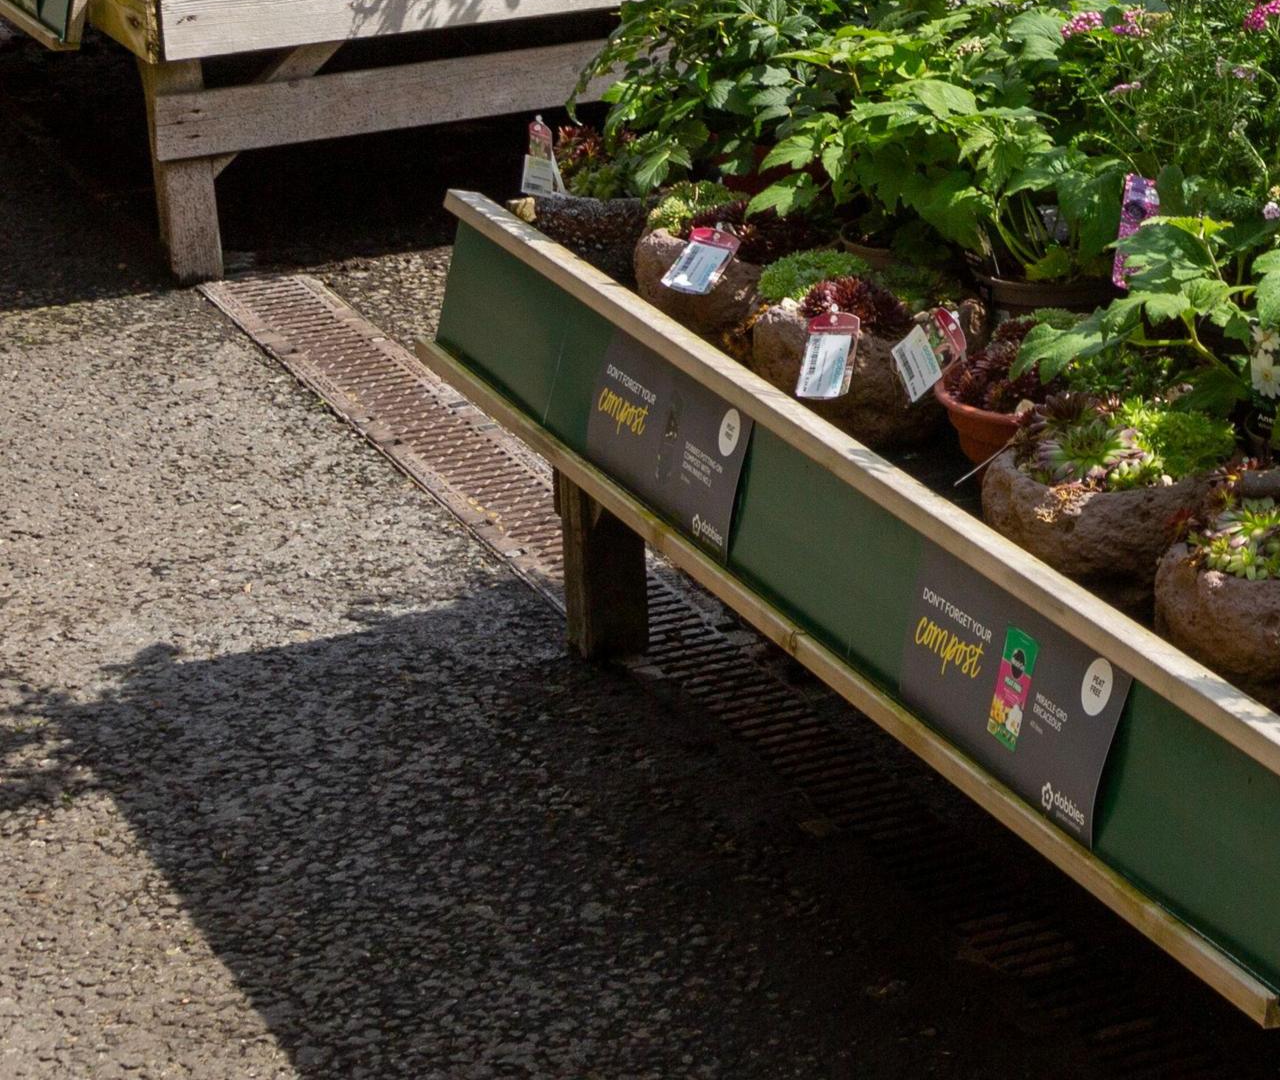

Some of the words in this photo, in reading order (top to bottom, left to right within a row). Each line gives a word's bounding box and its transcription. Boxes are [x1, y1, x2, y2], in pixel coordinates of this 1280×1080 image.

[606, 363, 623, 383] DON'T
[621, 374, 643, 396] FORGET
[640, 388, 657, 405] YOUR
[598, 387, 650, 436] compost
[701, 520, 723, 546] dobbies
[923, 587, 946, 611] DON'T
[944, 602, 973, 629] FORGET
[971, 620, 993, 644] YOUR
[915, 616, 984, 678] compost
[1089, 684, 1102, 699] FREE
[1092, 674, 1106, 689] PEAT
[1032, 702, 1063, 733] ERICACEOUS
[1035, 691, 1068, 723] MIRACLE-GRO
[1054, 791, 1085, 826] dobbies
